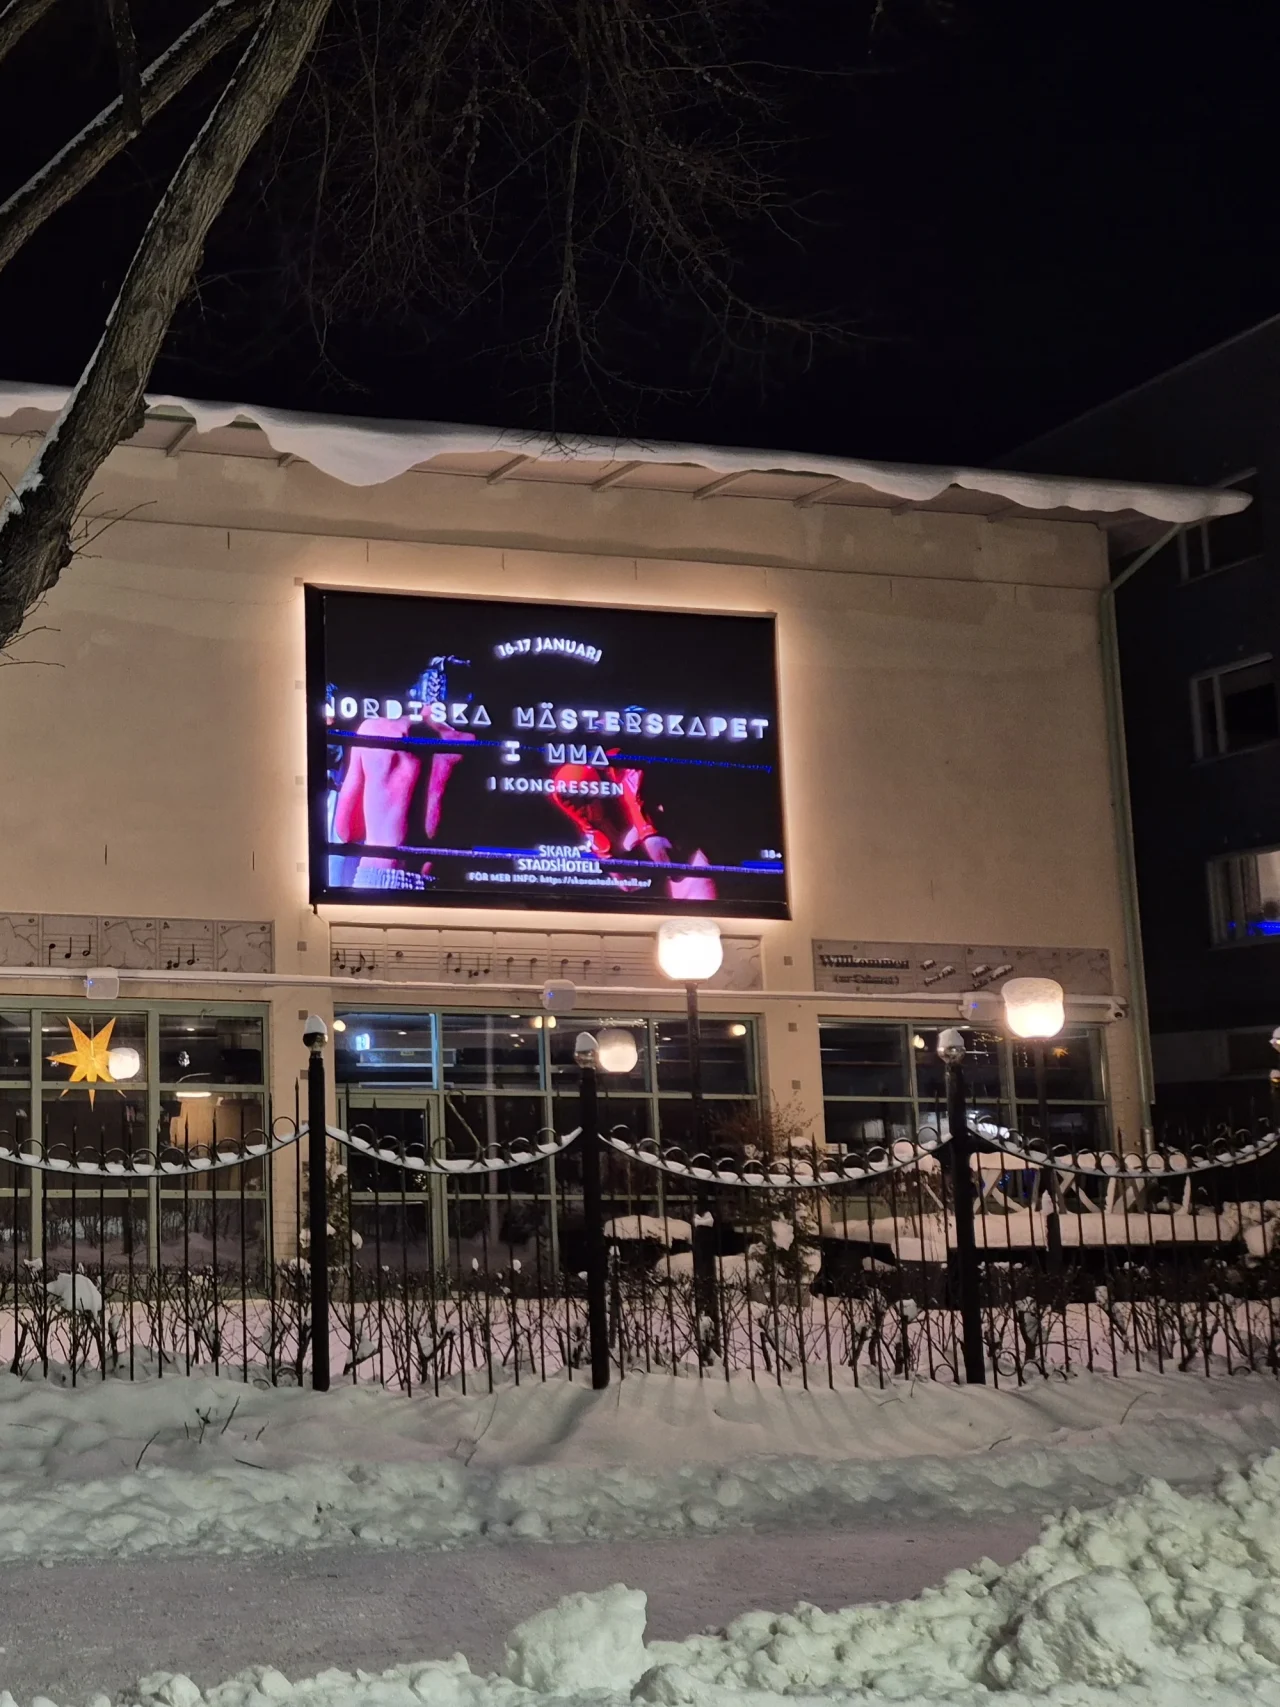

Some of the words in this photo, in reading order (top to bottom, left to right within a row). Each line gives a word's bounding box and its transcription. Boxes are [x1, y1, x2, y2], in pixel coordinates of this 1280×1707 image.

[497, 638, 531, 657] 16-17
[534, 636, 603, 663] JANUARI
[515, 701, 770, 740] MÄSTERSKAPET
[503, 740, 520, 763] I
[548, 742, 610, 766] MMA
[488, 776, 497, 791] I
[504, 776, 625, 796] KONGRESSEN
[538, 844, 582, 859] SKARA
[468, 871, 490, 882] FÖR
[490, 873, 512, 883] MER
[513, 874, 539, 884] INFO:
